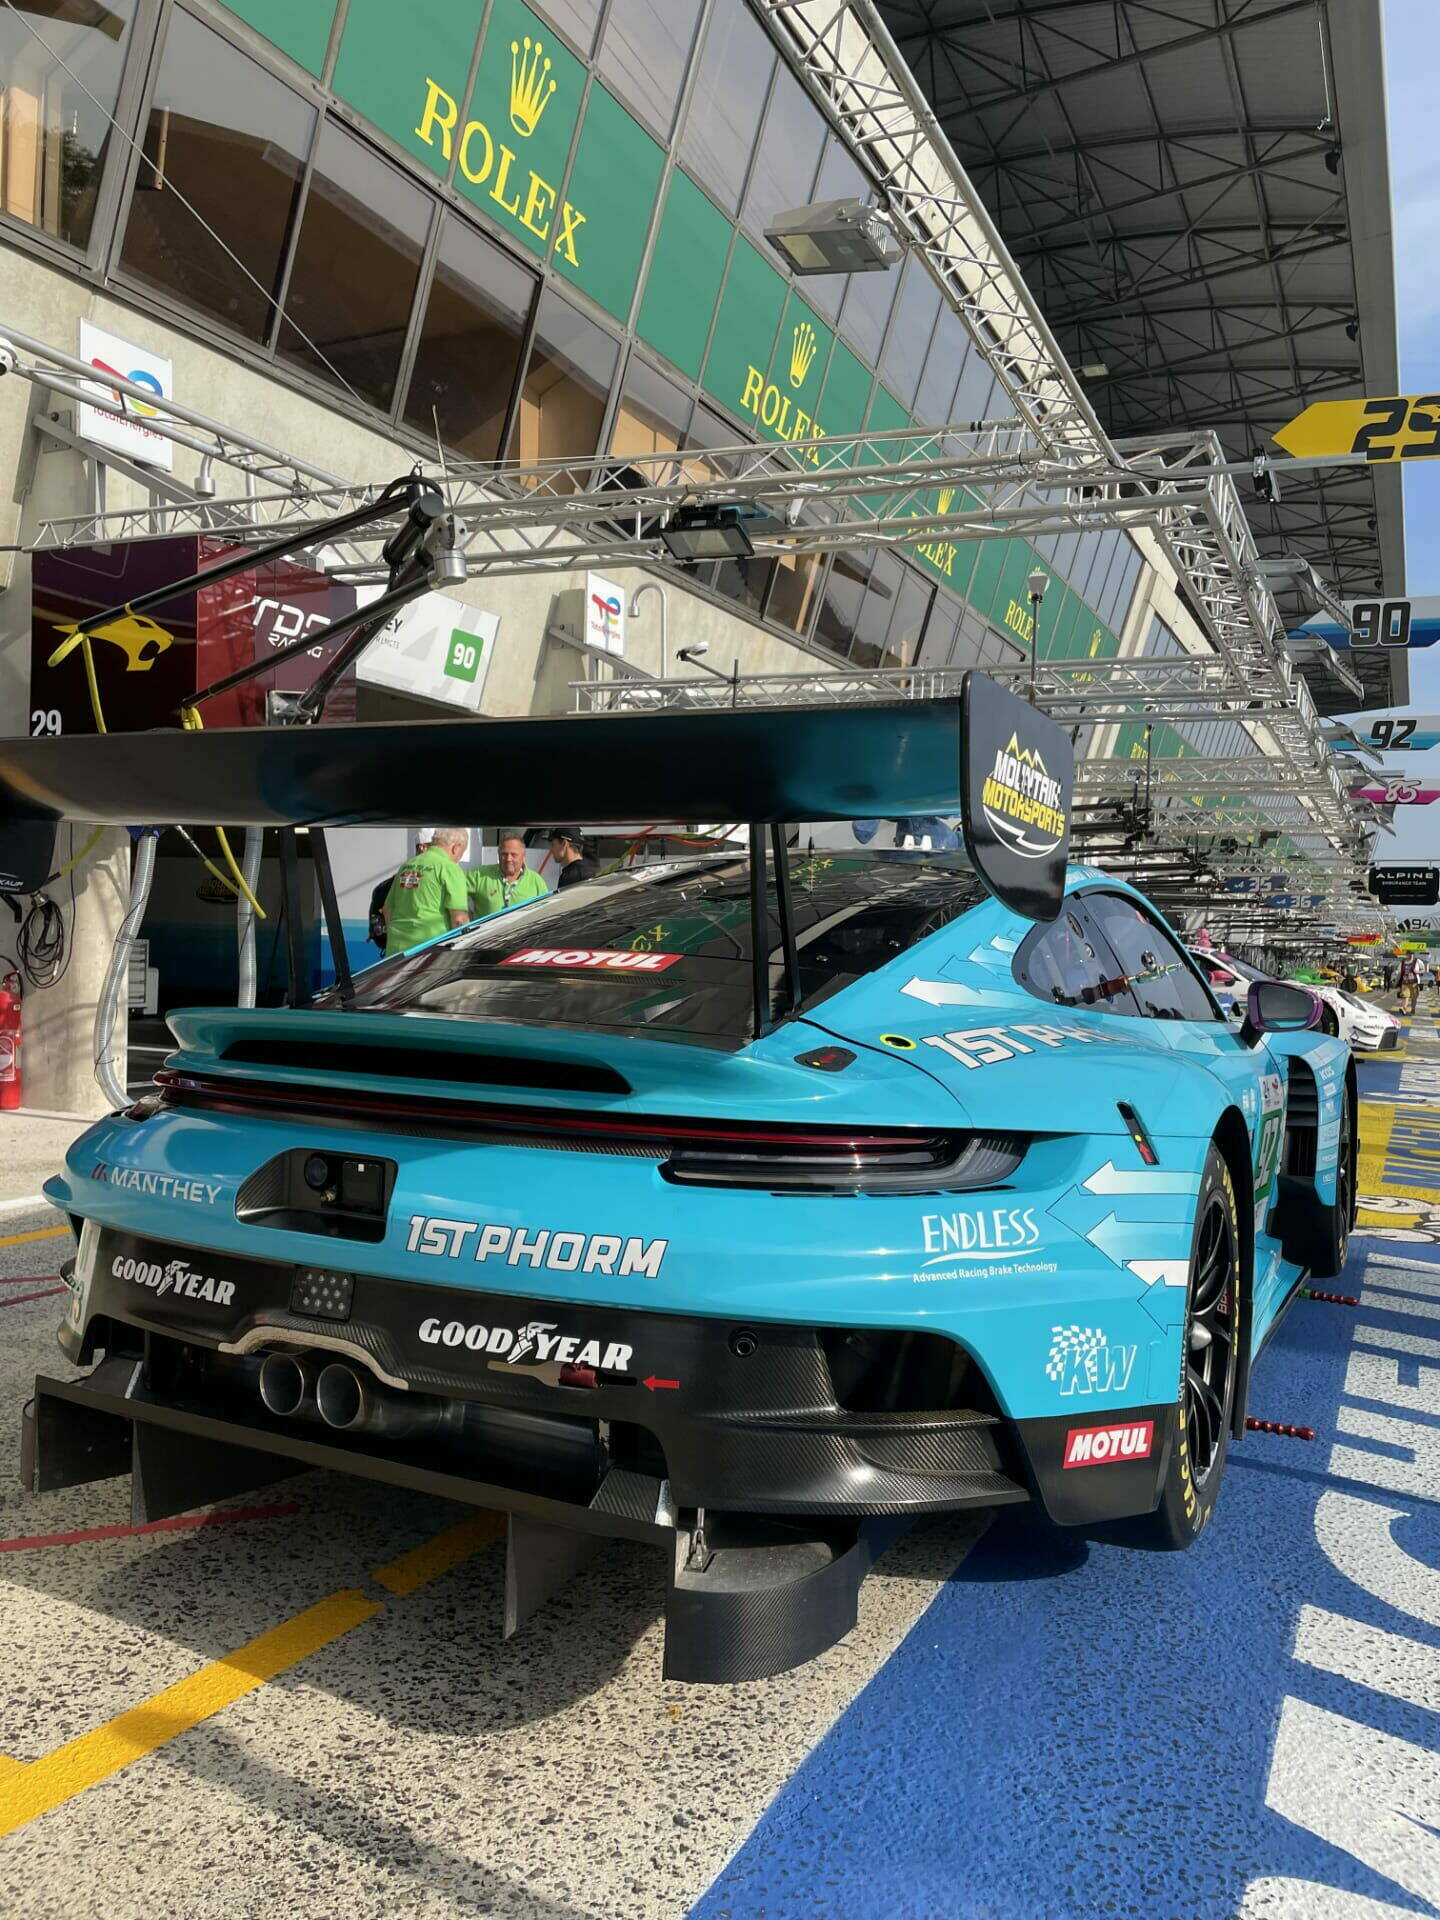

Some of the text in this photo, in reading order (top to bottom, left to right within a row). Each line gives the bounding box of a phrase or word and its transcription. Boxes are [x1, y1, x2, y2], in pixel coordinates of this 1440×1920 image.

[415, 77, 586, 267] ROLEX
[740, 365, 826, 466] ROLEX
[1004, 600, 1040, 644] ROLE
[1350, 601, 1411, 647] 90
[453, 643, 476, 669] 90
[32, 709, 62, 737] 29
[1370, 720, 1417, 748] 92
[983, 777, 1065, 837] MOTORSPORTS
[1385, 779, 1421, 803] 85
[1411, 919, 1431, 930] 94
[509, 950, 666, 969] MOTUL
[919, 1025, 1036, 1070] 1ST
[110, 1166, 222, 1205] MANTHEY
[406, 1214, 669, 1278] 1ST PHORM
[922, 1207, 1040, 1252] ENDLESS
[912, 1261, 1057, 1283] Advanced Racing Brake Technology
[1059, 1344, 1137, 1396] KW
[1067, 1427, 1148, 1463] MOTUL
